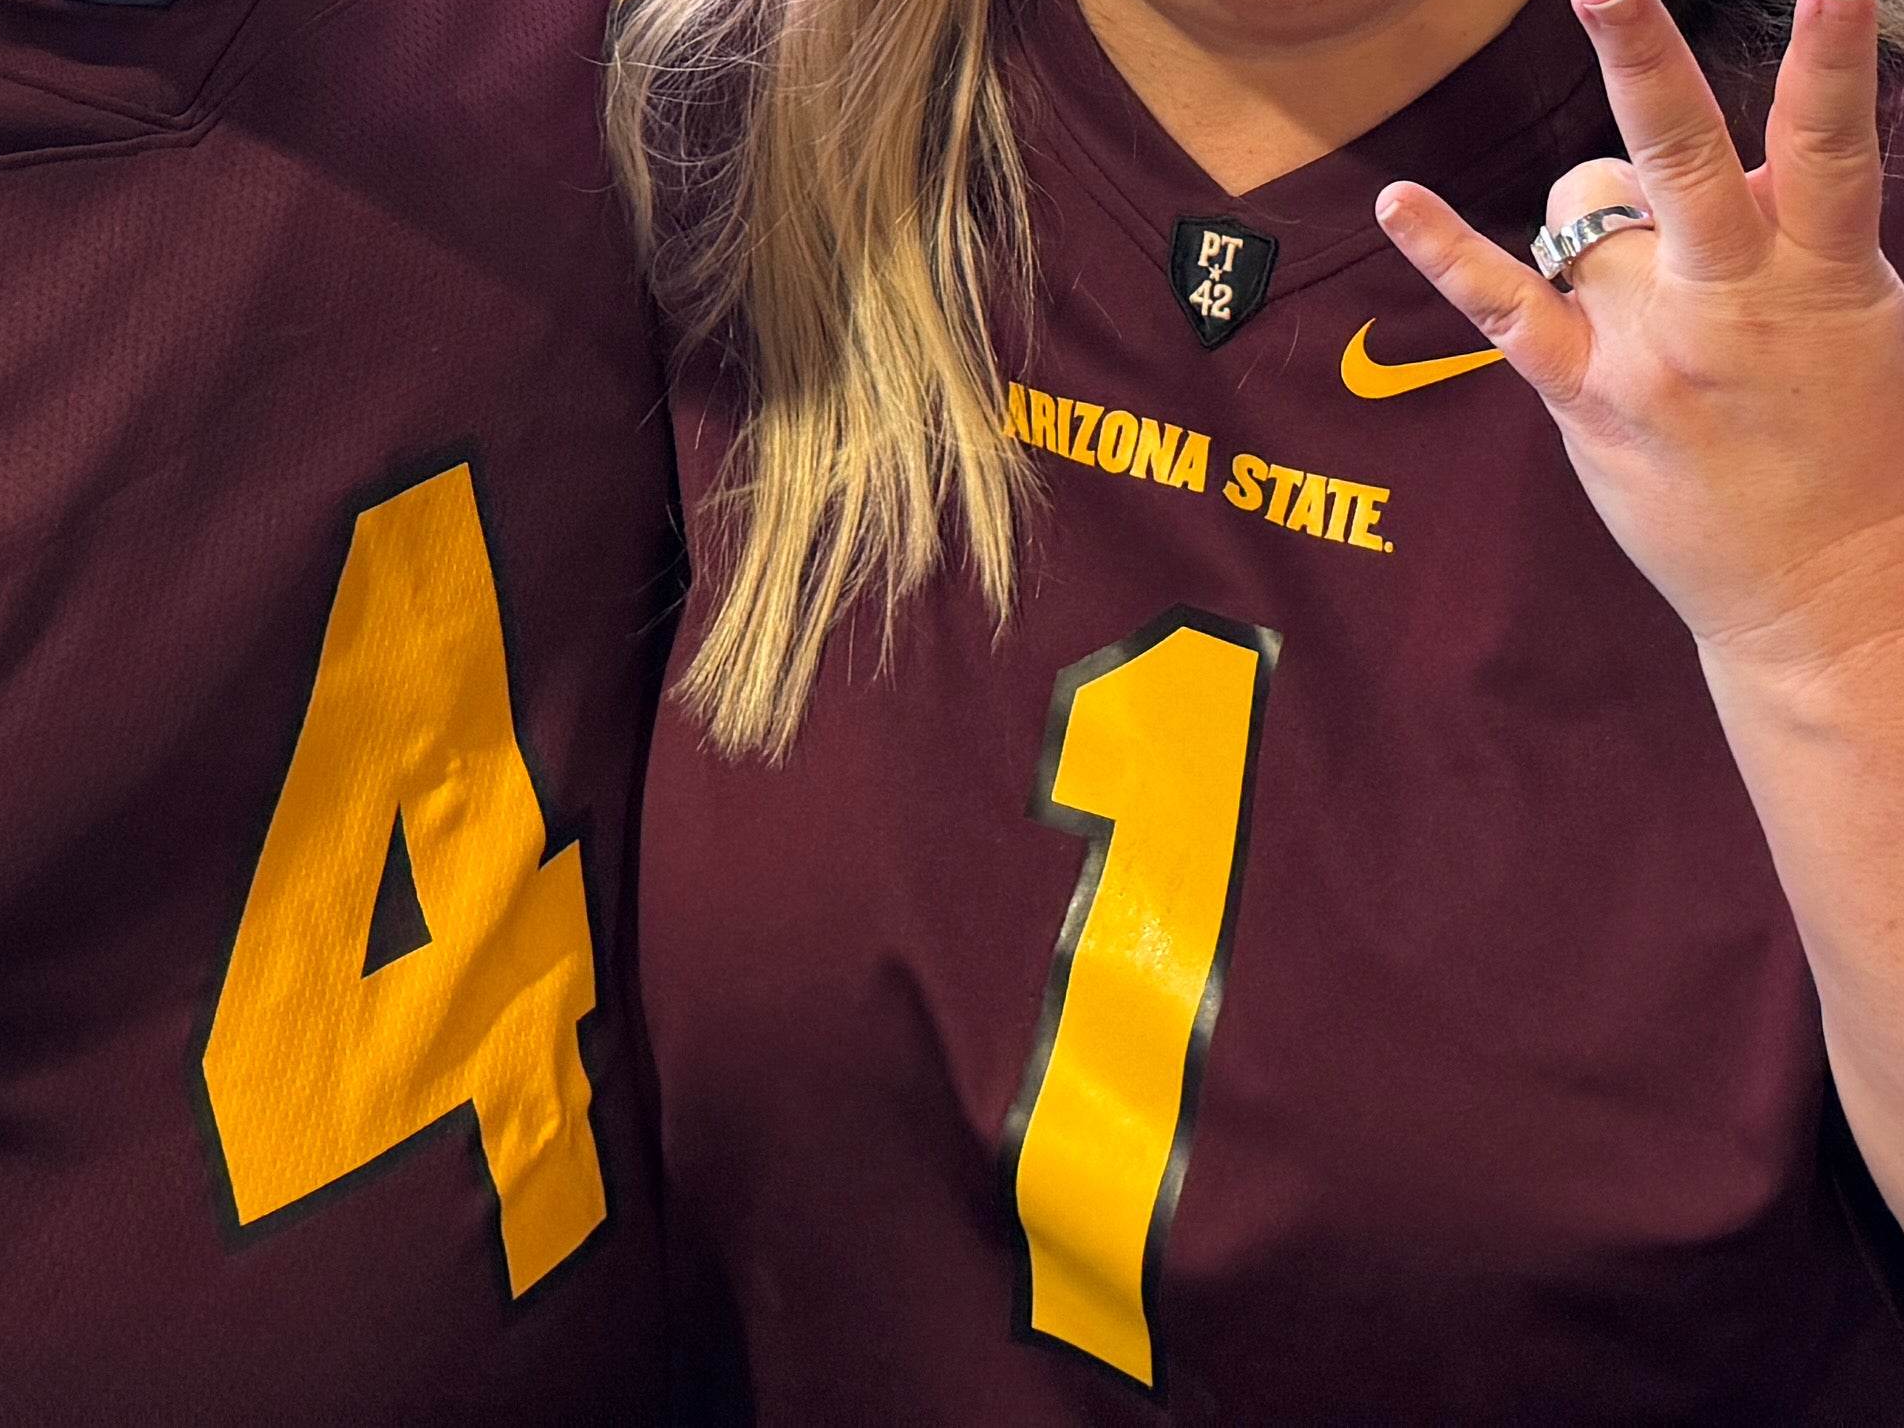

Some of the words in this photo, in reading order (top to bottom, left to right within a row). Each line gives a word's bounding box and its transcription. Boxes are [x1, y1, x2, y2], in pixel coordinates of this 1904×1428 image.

[1188, 280, 1232, 320] 42
[1198, 230, 1243, 268] PT
[1004, 381, 1211, 493] ARIZONA
[202, 462, 607, 1299] 4
[1017, 626, 1258, 1388] 1
